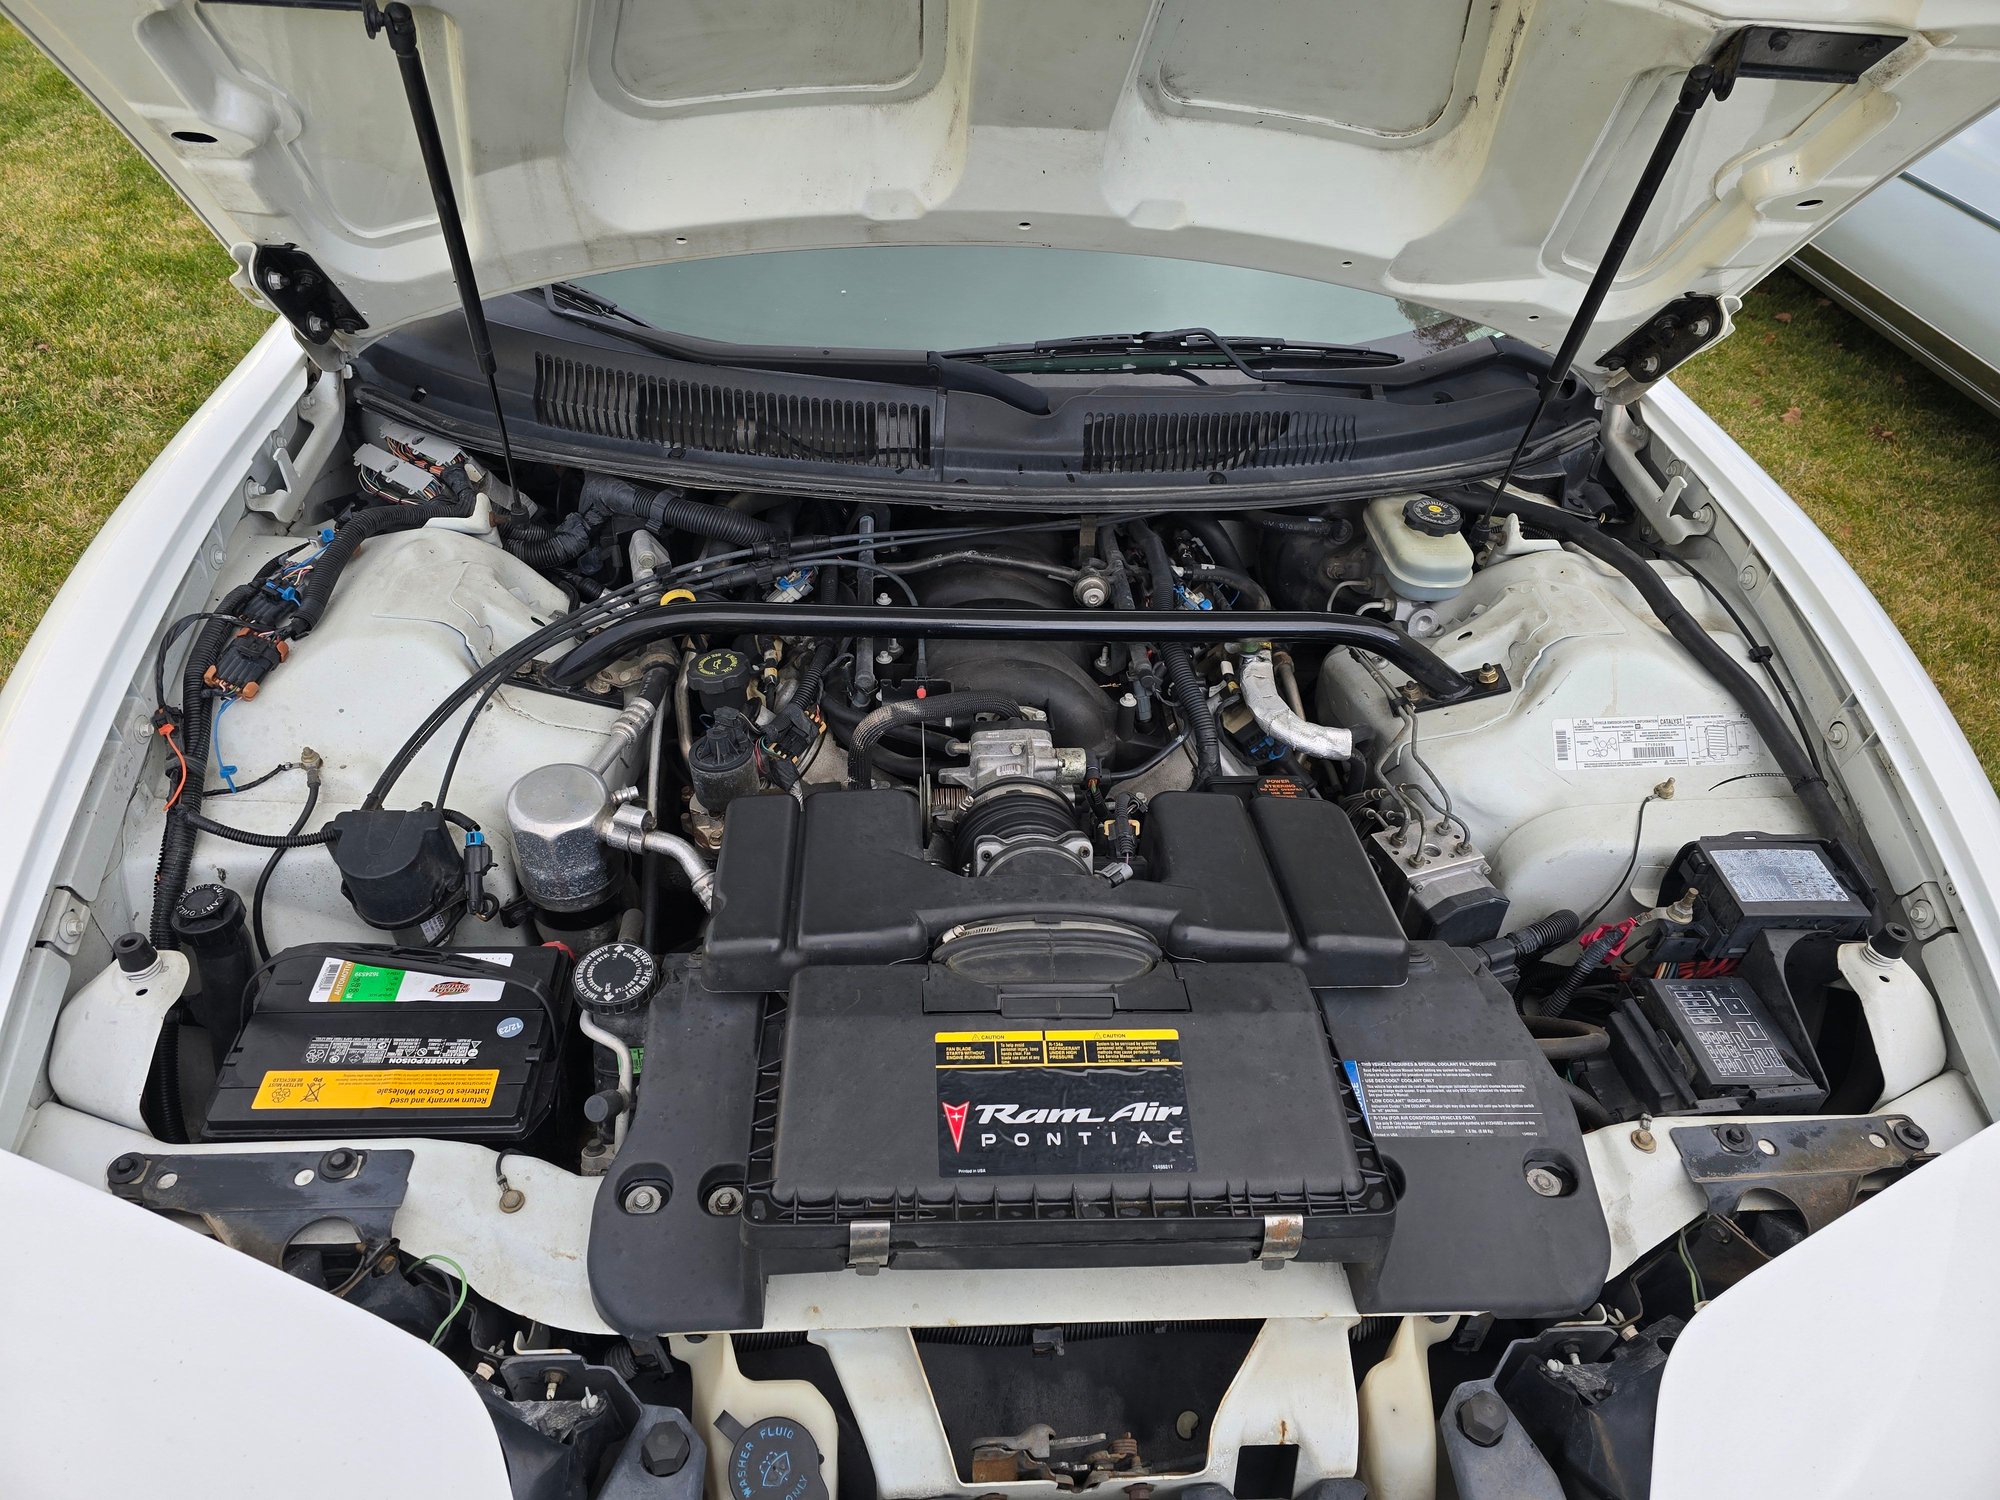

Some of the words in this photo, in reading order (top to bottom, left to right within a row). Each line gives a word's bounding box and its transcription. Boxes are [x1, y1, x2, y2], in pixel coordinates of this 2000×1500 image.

[633, 948, 652, 966] NEVER
[625, 985, 641, 998] HOT
[498, 1022, 522, 1035] 12/23
[975, 1104, 1106, 1124] Ram
[1109, 1102, 1183, 1122] Air
[982, 1131, 1183, 1147] PONTIAC
[760, 1427, 794, 1439] FLUID
[738, 1442, 754, 1498] WASHER
[786, 1475, 807, 1500] ONLY
